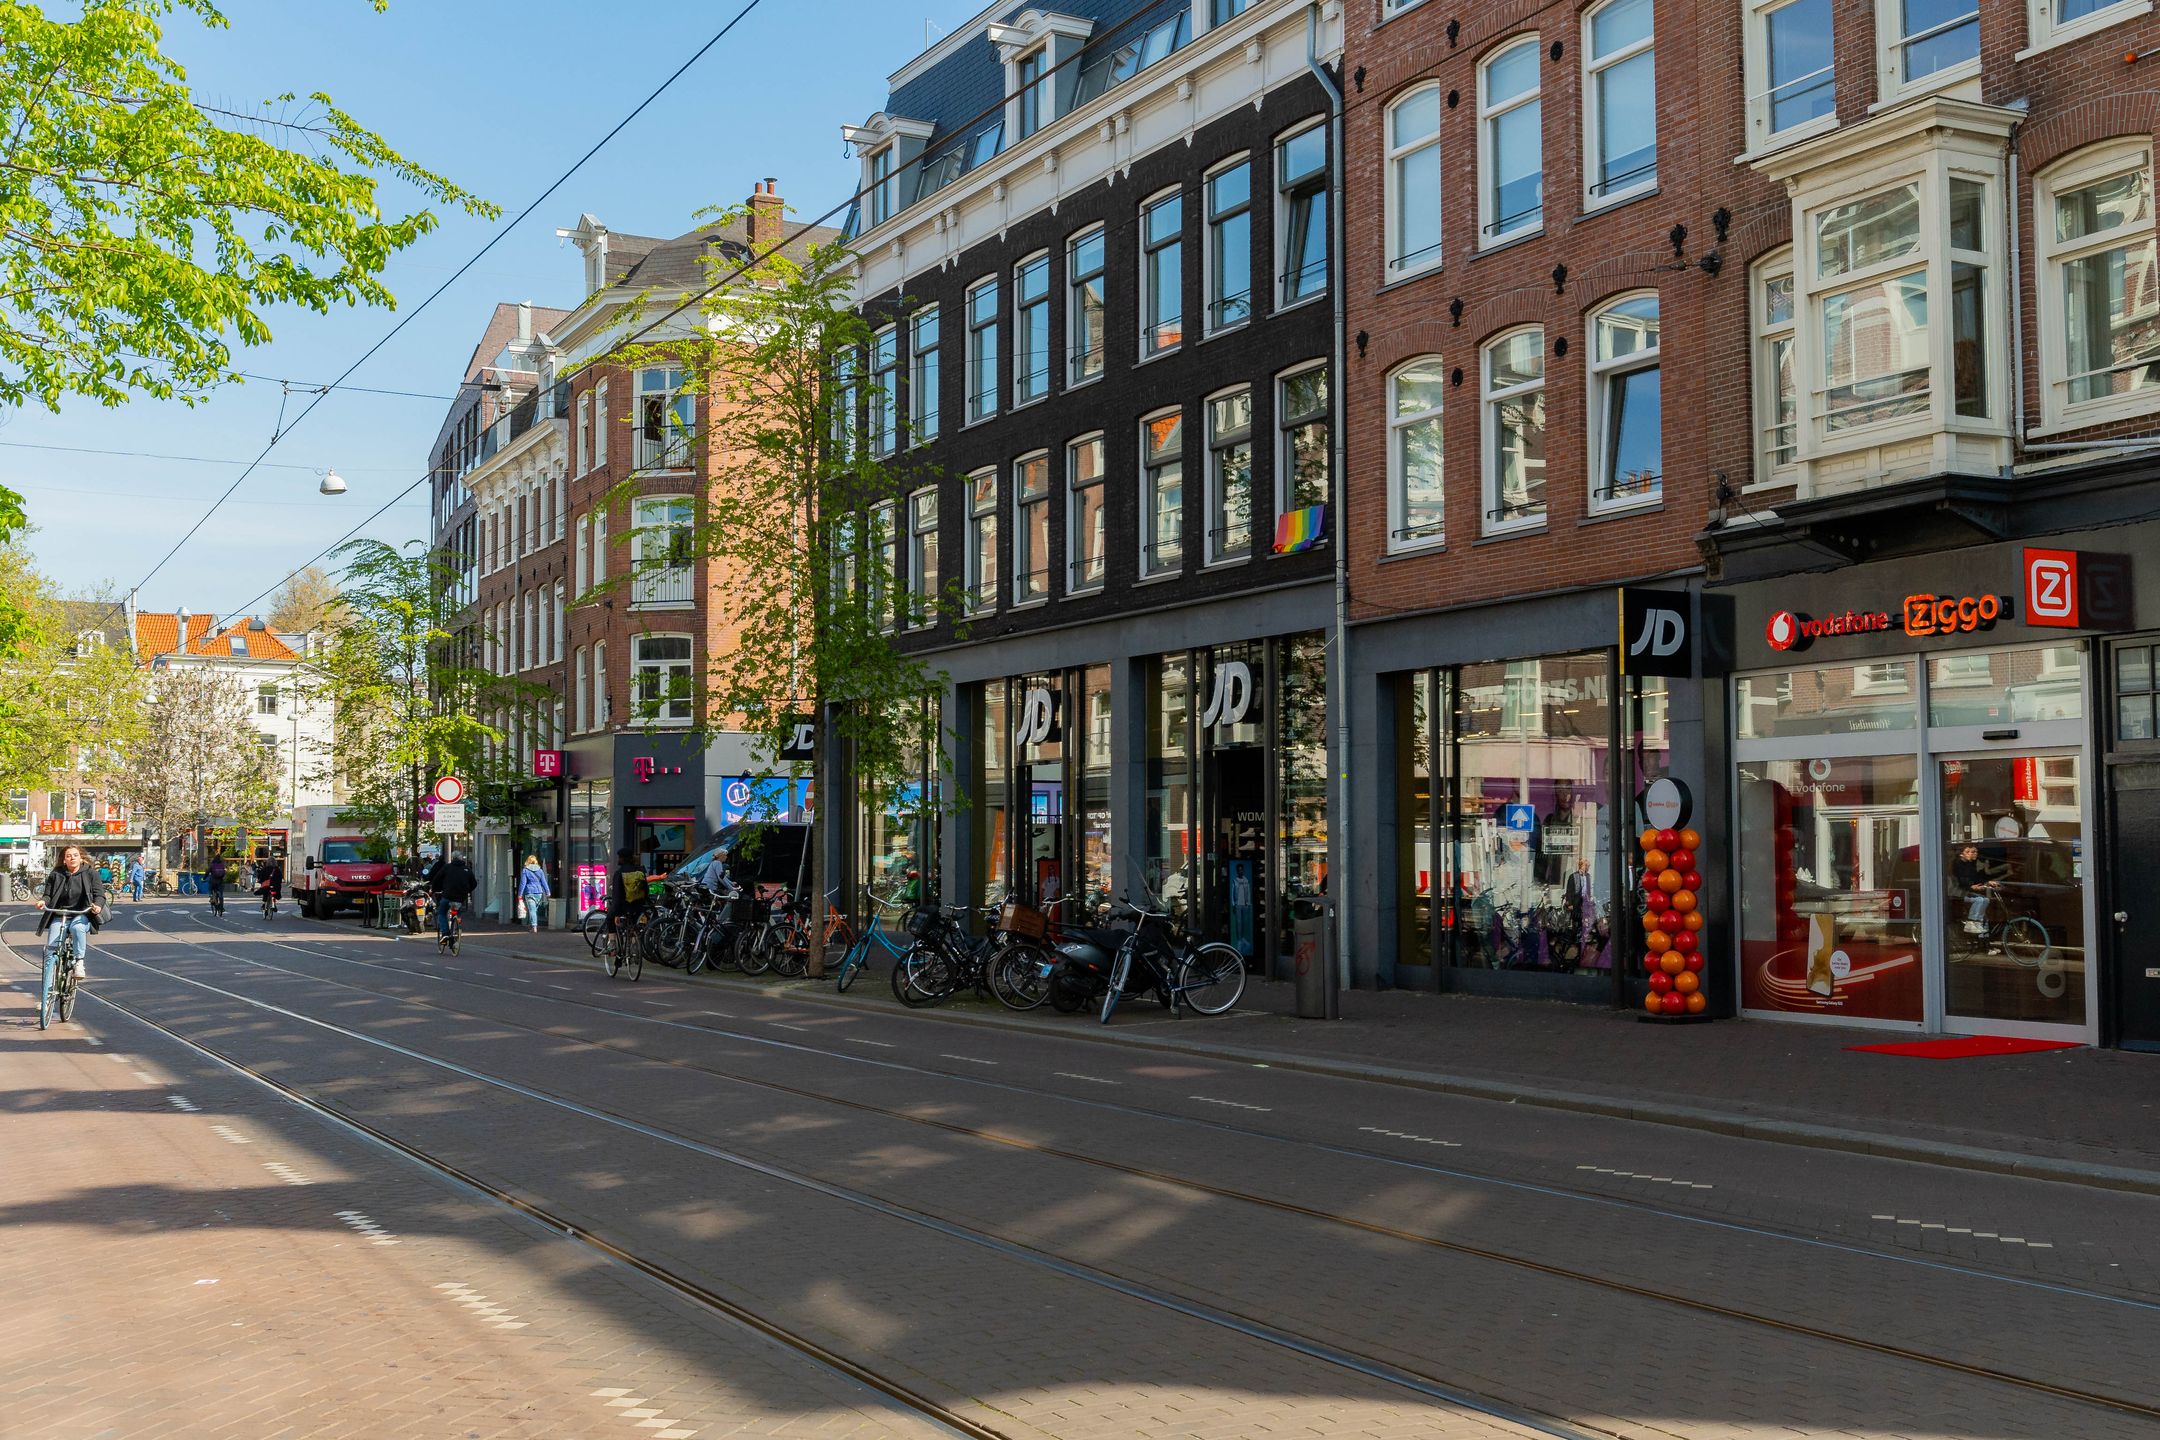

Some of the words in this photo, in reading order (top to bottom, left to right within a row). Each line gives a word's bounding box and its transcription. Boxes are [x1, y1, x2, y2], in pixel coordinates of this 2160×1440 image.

[1630, 608, 1685, 656] JD
[1799, 609, 1888, 638] vodafone
[1203, 661, 1251, 728] JD
[1017, 688, 1052, 746] JD
[539, 753, 555, 772] T
[1797, 782, 1846, 793] vodafone
